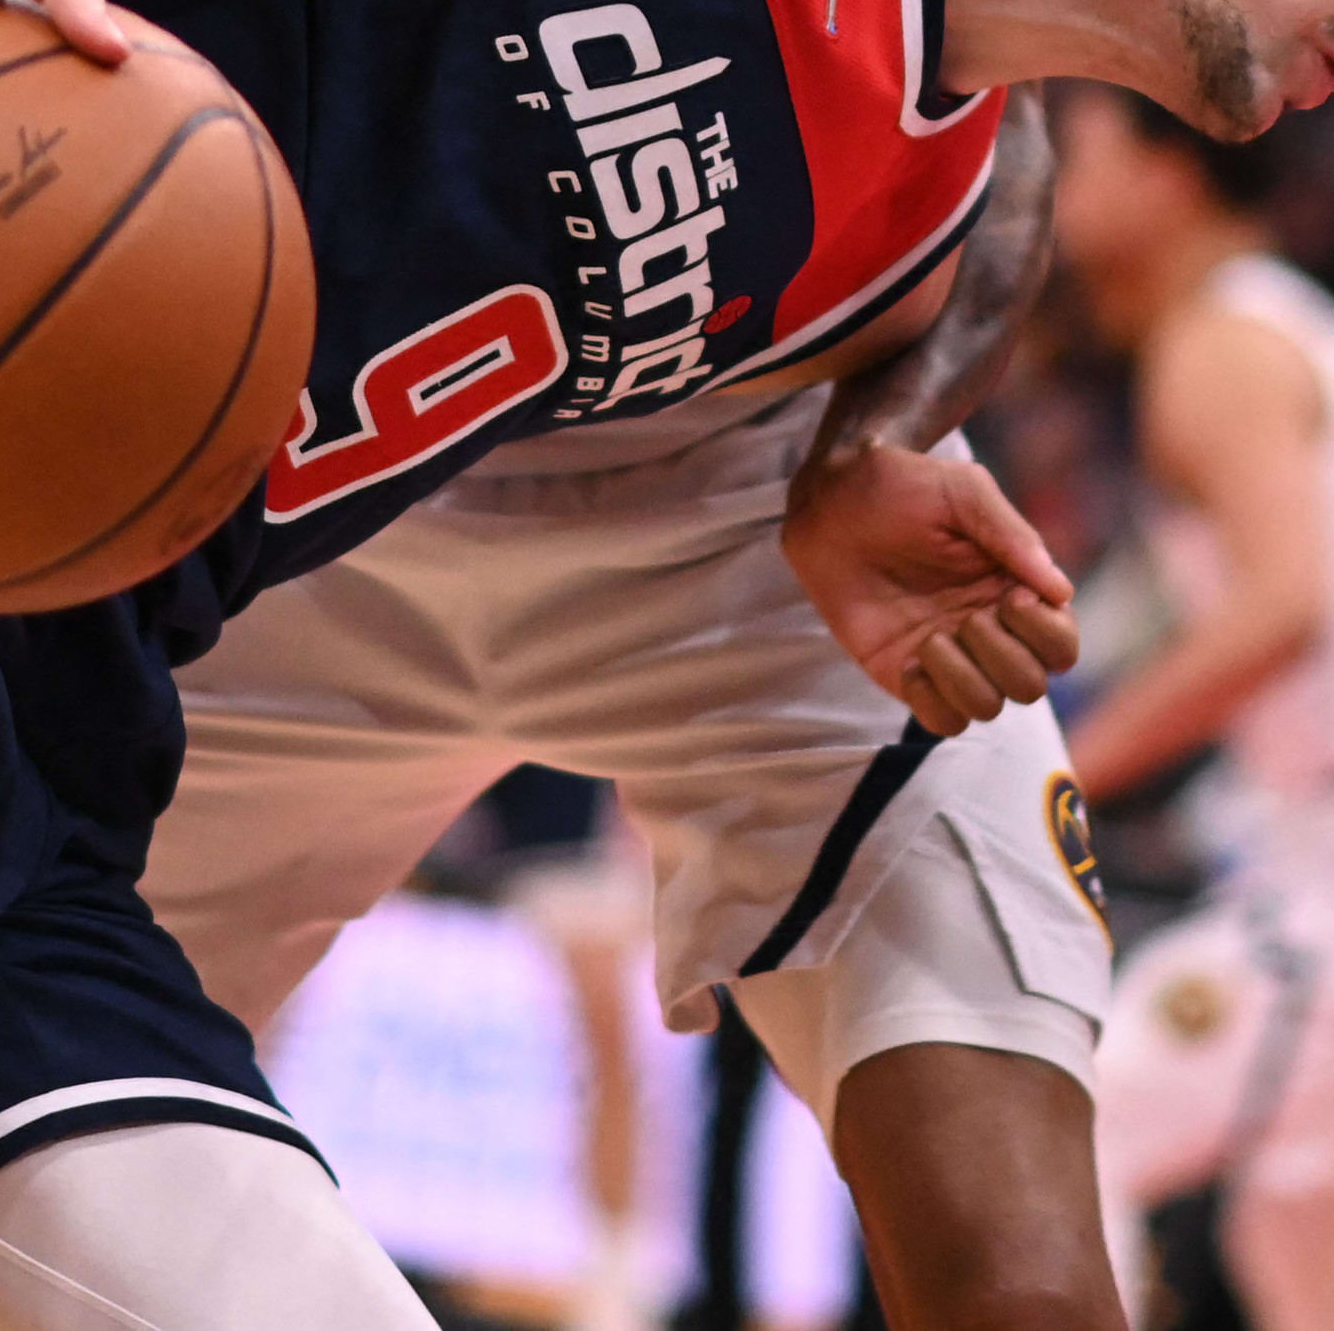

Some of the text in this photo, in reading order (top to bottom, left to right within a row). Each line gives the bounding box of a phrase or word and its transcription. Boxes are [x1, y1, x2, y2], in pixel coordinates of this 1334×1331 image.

[496, 33, 613, 419] OF COLUMBIA
[696, 110, 738, 200] THE
[263, 283, 569, 524] 9
